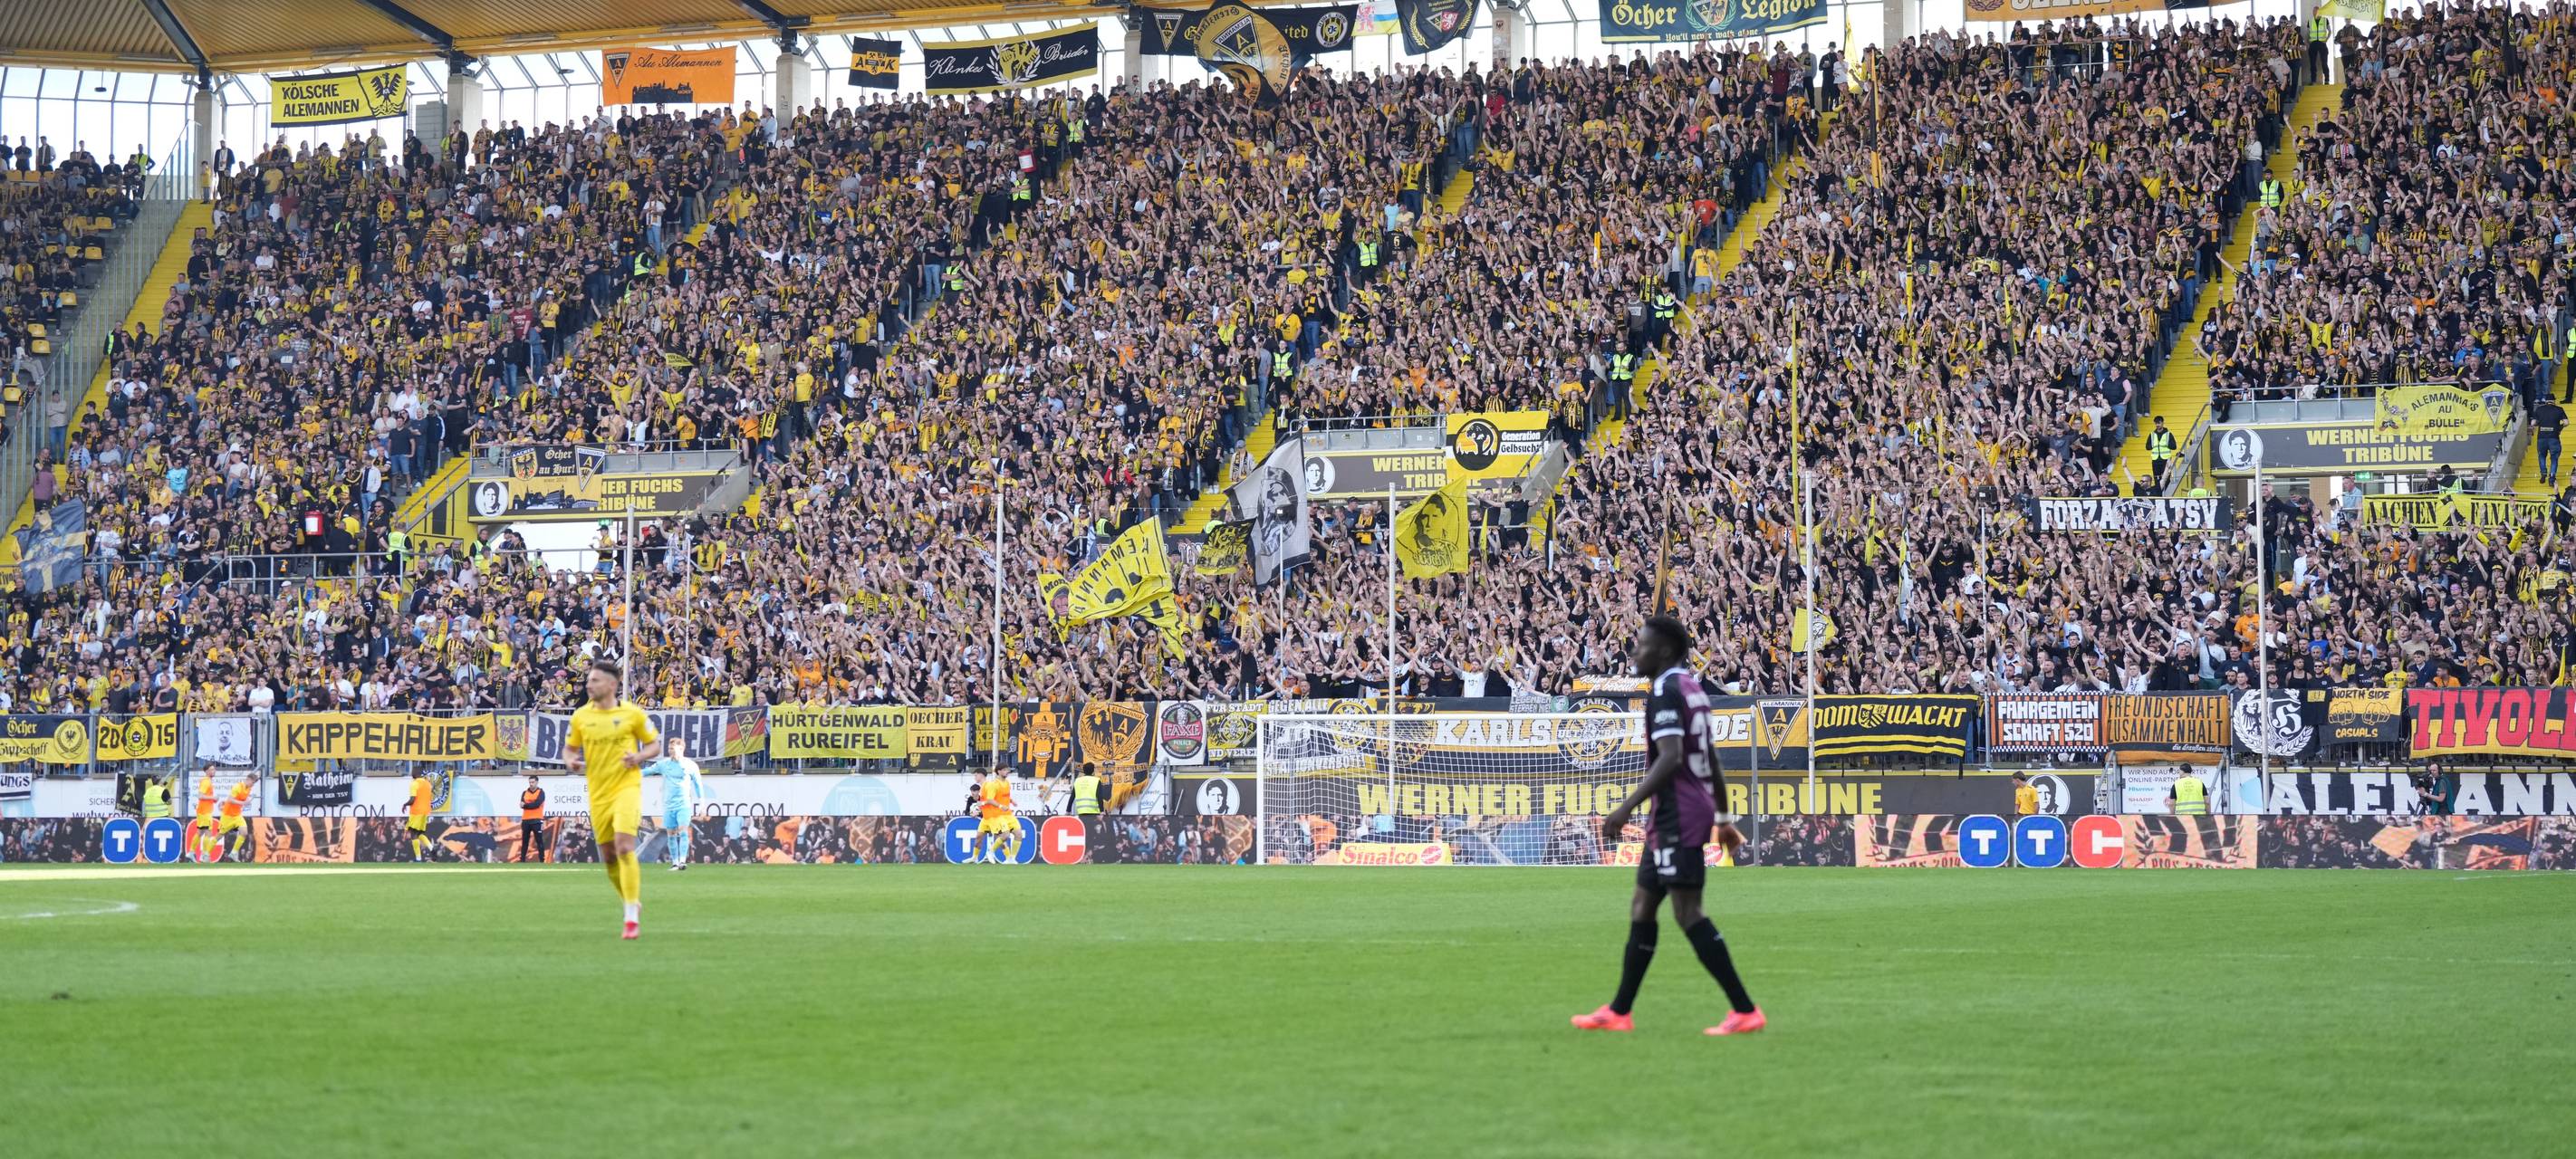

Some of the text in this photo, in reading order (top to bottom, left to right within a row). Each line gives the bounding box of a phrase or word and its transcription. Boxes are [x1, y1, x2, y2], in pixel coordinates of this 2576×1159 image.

[1612, 0, 1677, 29] Öcher
[282, 83, 340, 101] KÖLSCHE
[283, 99, 360, 118] ALEMANNEN
[2438, 405, 2452, 414] AU
[1501, 430, 1541, 442] Generation
[544, 446, 573, 460] Öcher
[2342, 444, 2434, 464] TRIBÜNE
[1372, 455, 1447, 472] WERNER
[630, 478, 683, 493] FUCHS
[2039, 499, 2218, 531] FORZA ATSV
[2366, 500, 2438, 525] AACHEN
[2332, 690, 2365, 699] NORTH
[2368, 690, 2391, 700] SIDE
[1229, 702, 1264, 714] STADT
[2108, 695, 2224, 719] FREUNDSCHAFT
[772, 711, 905, 728] HÜRTGENWALD
[909, 712, 964, 724] OECHER
[1886, 704, 1967, 729] WACHT
[7, 717, 38, 737] Öcher
[287, 715, 486, 755] KAPPEHÄUER
[1165, 724, 1200, 736] FAXE
[1435, 719, 1552, 747] KARLS
[2003, 723, 2095, 742] SCHAFT 520
[2107, 719, 2224, 743] ZUSAMMENHALT
[2335, 727, 2379, 739] CASUALS
[788, 733, 889, 750] RUREIFEL
[916, 736, 954, 749] KRAU
[1207, 748, 1224, 759] ND
[303, 771, 354, 790] Ratheim
[554, 796, 582, 804] SICHER
[1357, 783, 1531, 816] WERNER
[1724, 777, 1884, 815] RIBÜNE
[1341, 845, 1418, 866] Sinalco
